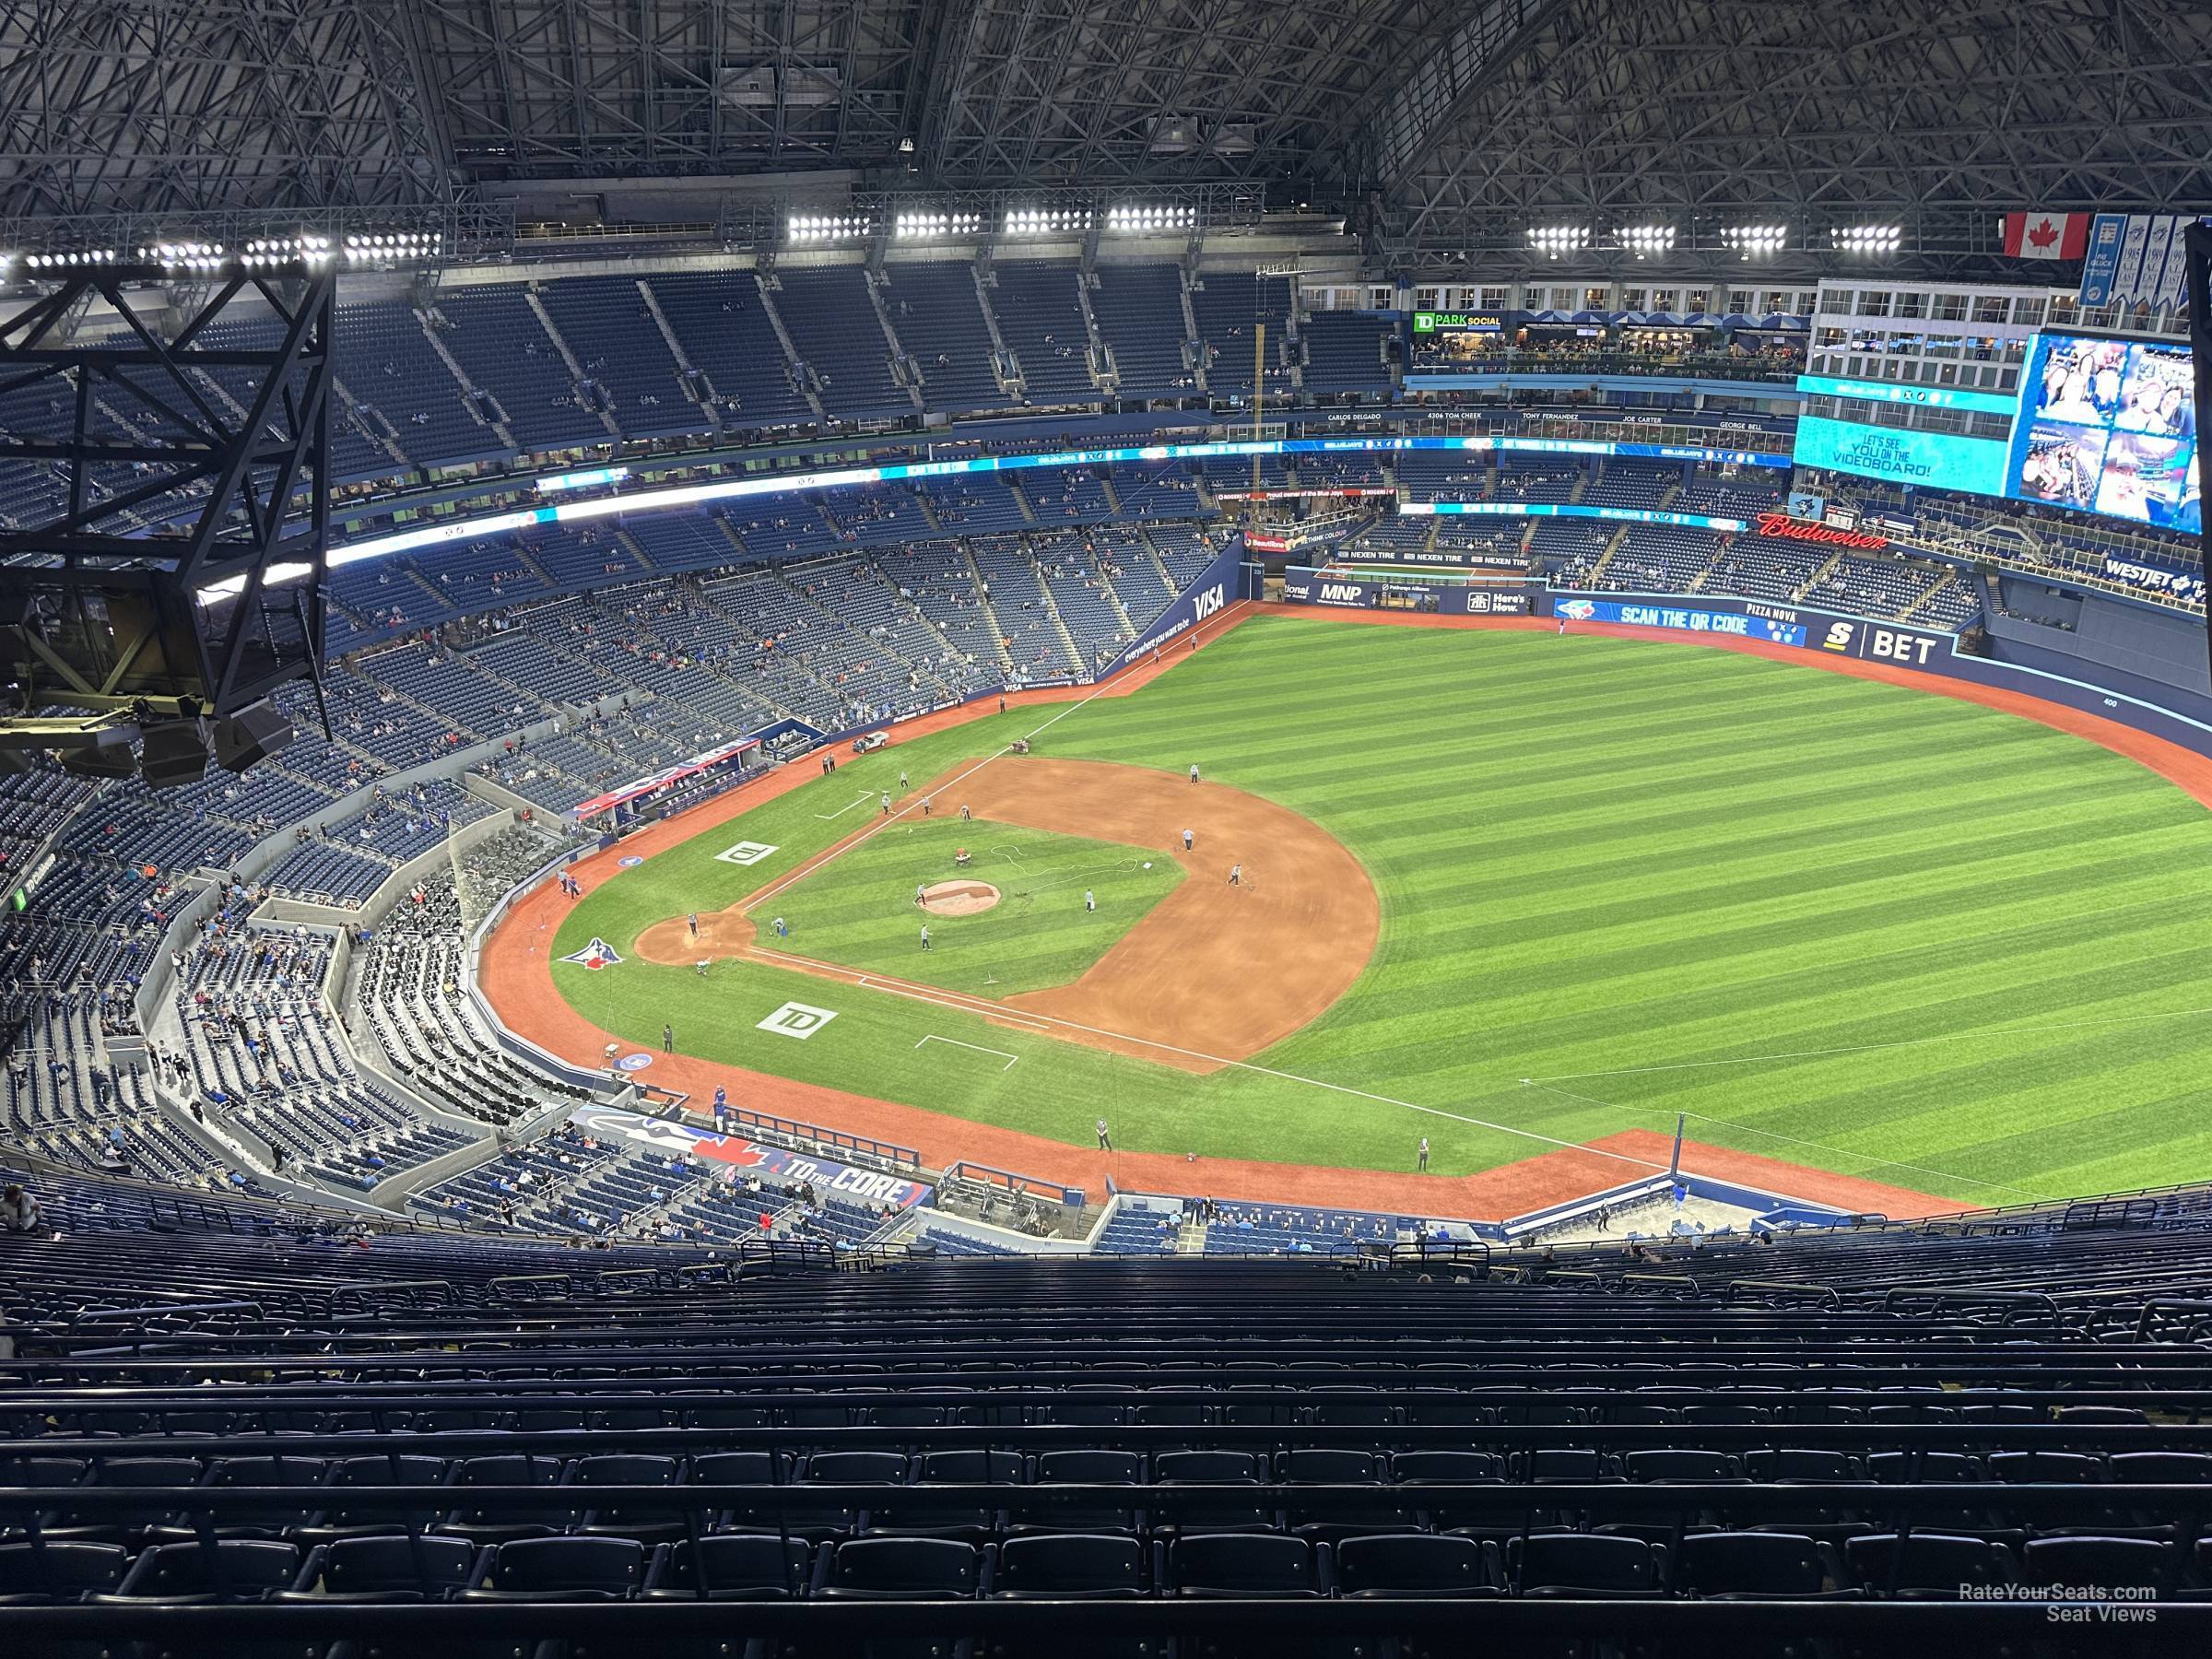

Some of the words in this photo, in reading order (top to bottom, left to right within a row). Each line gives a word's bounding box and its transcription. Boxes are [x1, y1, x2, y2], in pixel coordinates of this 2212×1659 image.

[2124, 248, 2141, 260] 1985
[1417, 315, 1433, 329] TD
[1435, 314, 1467, 325] PARK
[1467, 317, 1501, 325] SOCIAL
[1720, 421, 1746, 429] GEORGE
[1747, 422, 1762, 430] BELL
[1864, 434, 1885, 447] LET'S
[1886, 437, 1900, 450] SEE
[1852, 443, 1879, 458] YOU
[1881, 448, 1892, 460] ON
[1894, 450, 1911, 463] THE
[1832, 451, 1932, 477] VIDEOBOARD!
[1300, 535, 1324, 546] RETHINK
[1324, 530, 1347, 540] COLOUR
[1757, 512, 1888, 549] Budweiser
[1417, 553, 1443, 561] NEXEN
[1485, 556, 1511, 565] NEXEN
[2106, 559, 2173, 587] WESTJET
[1321, 583, 1362, 600] MNP
[1492, 593, 1525, 604] Here's
[1193, 582, 1224, 621] VISA
[1492, 602, 1519, 612] How.
[1620, 606, 1659, 625] SCAN
[1662, 609, 1688, 628] THE
[1690, 611, 1711, 630] QR
[1712, 614, 1747, 634] CODE
[1746, 604, 1771, 617] PIZZA
[1773, 607, 1796, 623] NOVA
[1155, 630, 1165, 647] you
[1164, 625, 1178, 641] want
[1182, 618, 1190, 628] be
[1873, 629, 1936, 665] BET
[1003, 683, 1023, 692] VISA
[2103, 698, 2118, 708] 400
[728, 847, 769, 861] TD
[777, 1007, 822, 1030] TD
[783, 1159, 818, 1180] TO
[806, 1171, 834, 1186] THE
[830, 1167, 912, 1204] CORE
